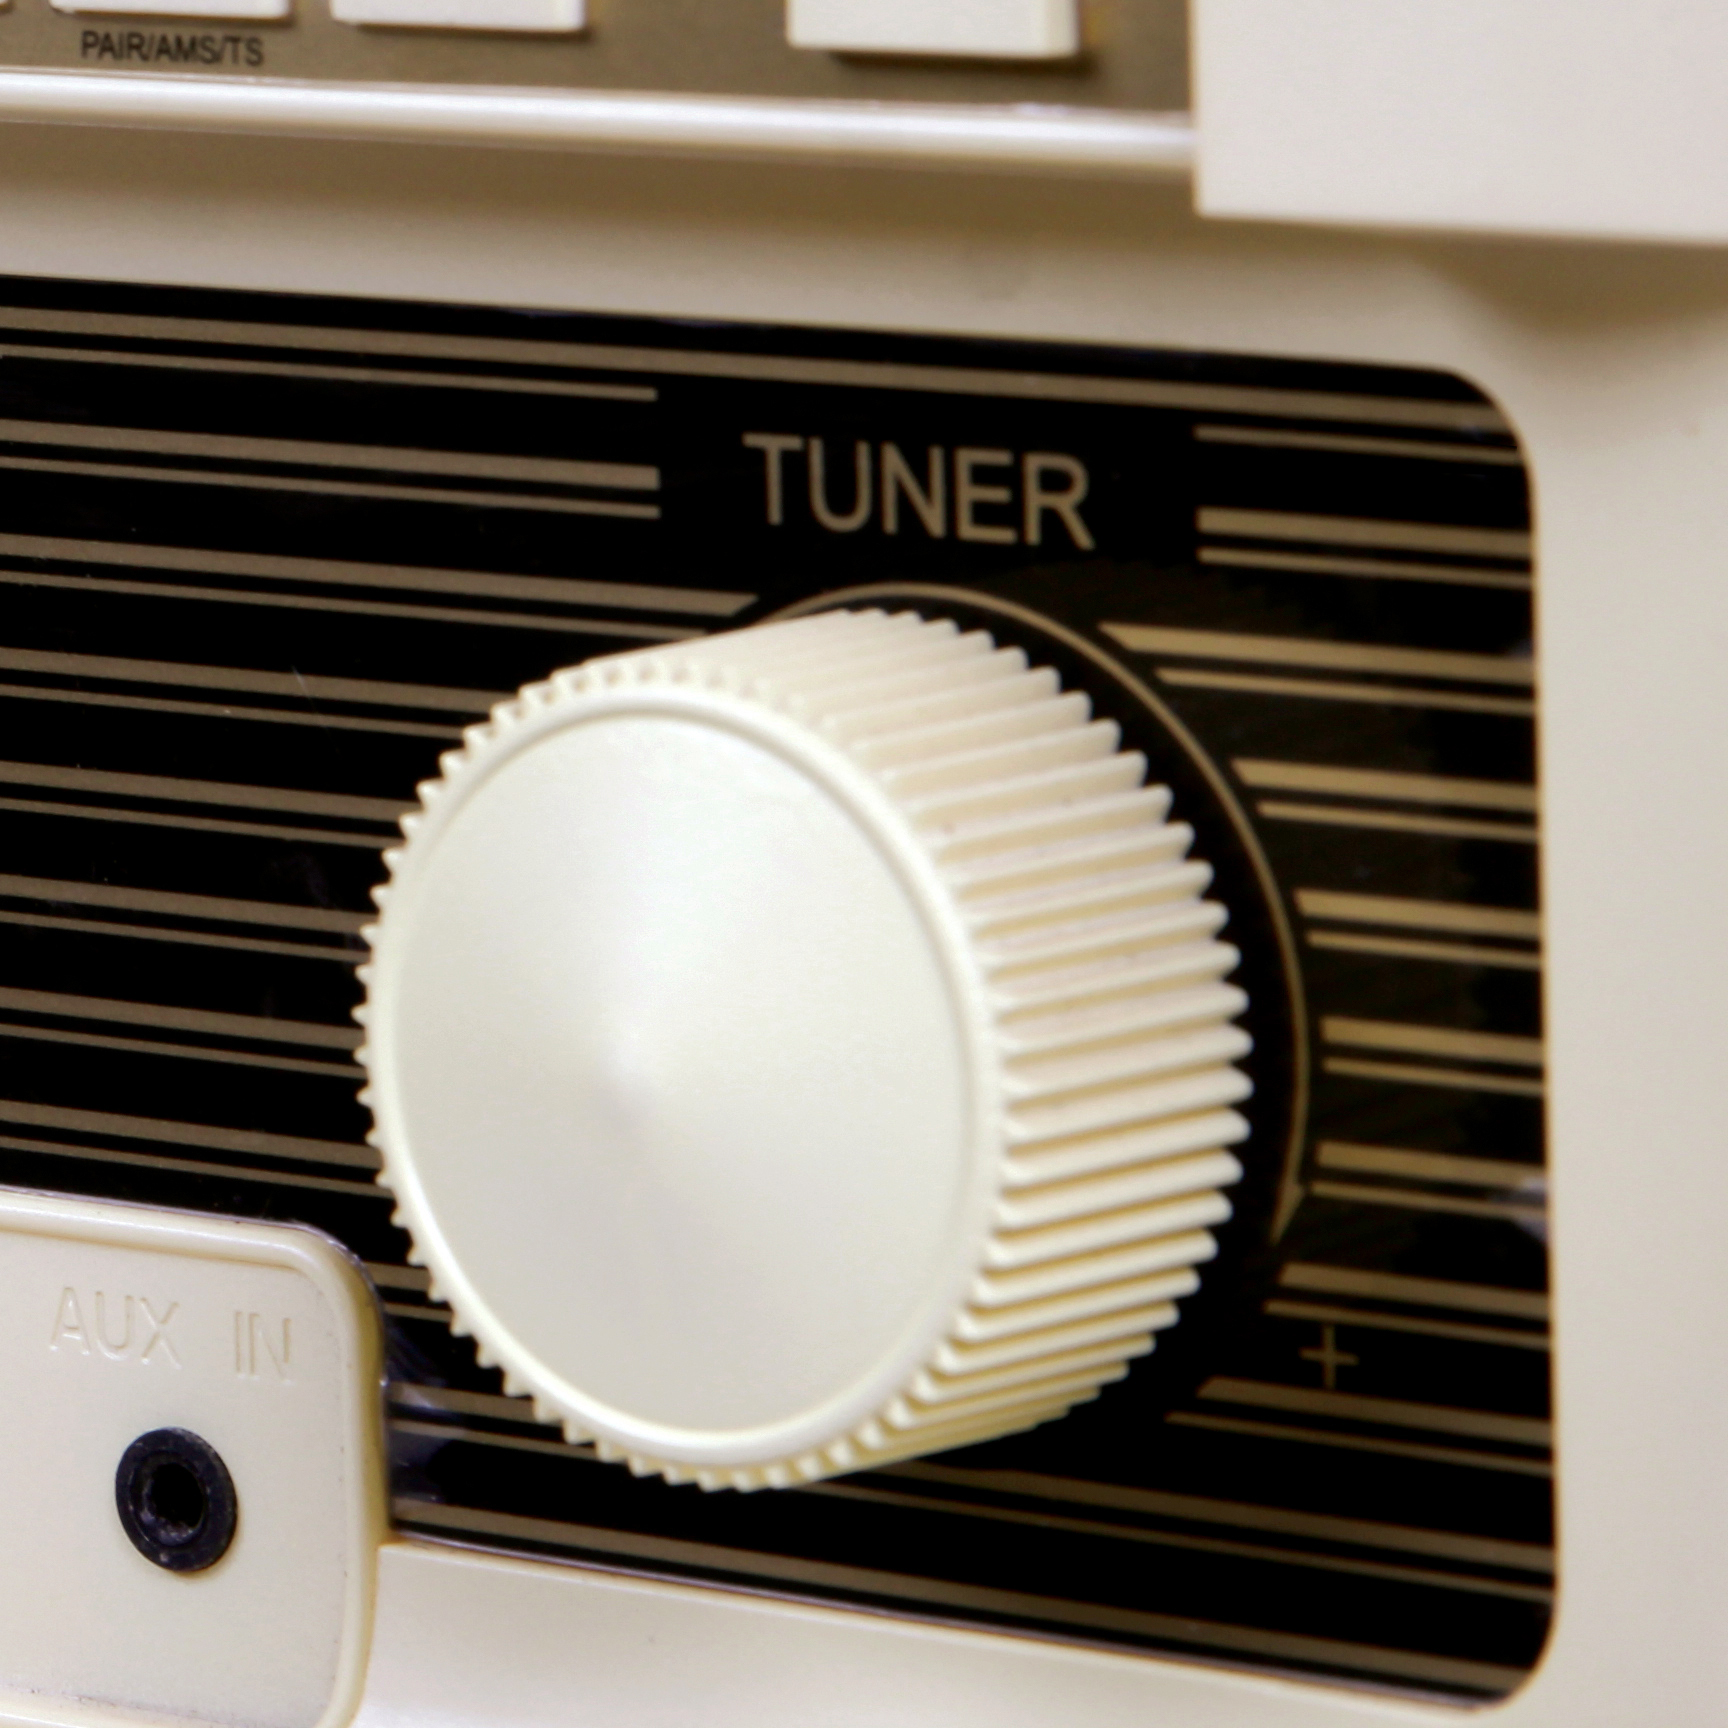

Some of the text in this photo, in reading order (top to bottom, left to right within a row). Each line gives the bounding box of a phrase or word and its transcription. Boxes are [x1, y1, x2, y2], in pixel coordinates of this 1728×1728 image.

[80, 29, 266, 67] PAIR/AMS/TS
[742, 431, 1097, 552] TUNER
[48, 1285, 295, 1386] AUX IN
